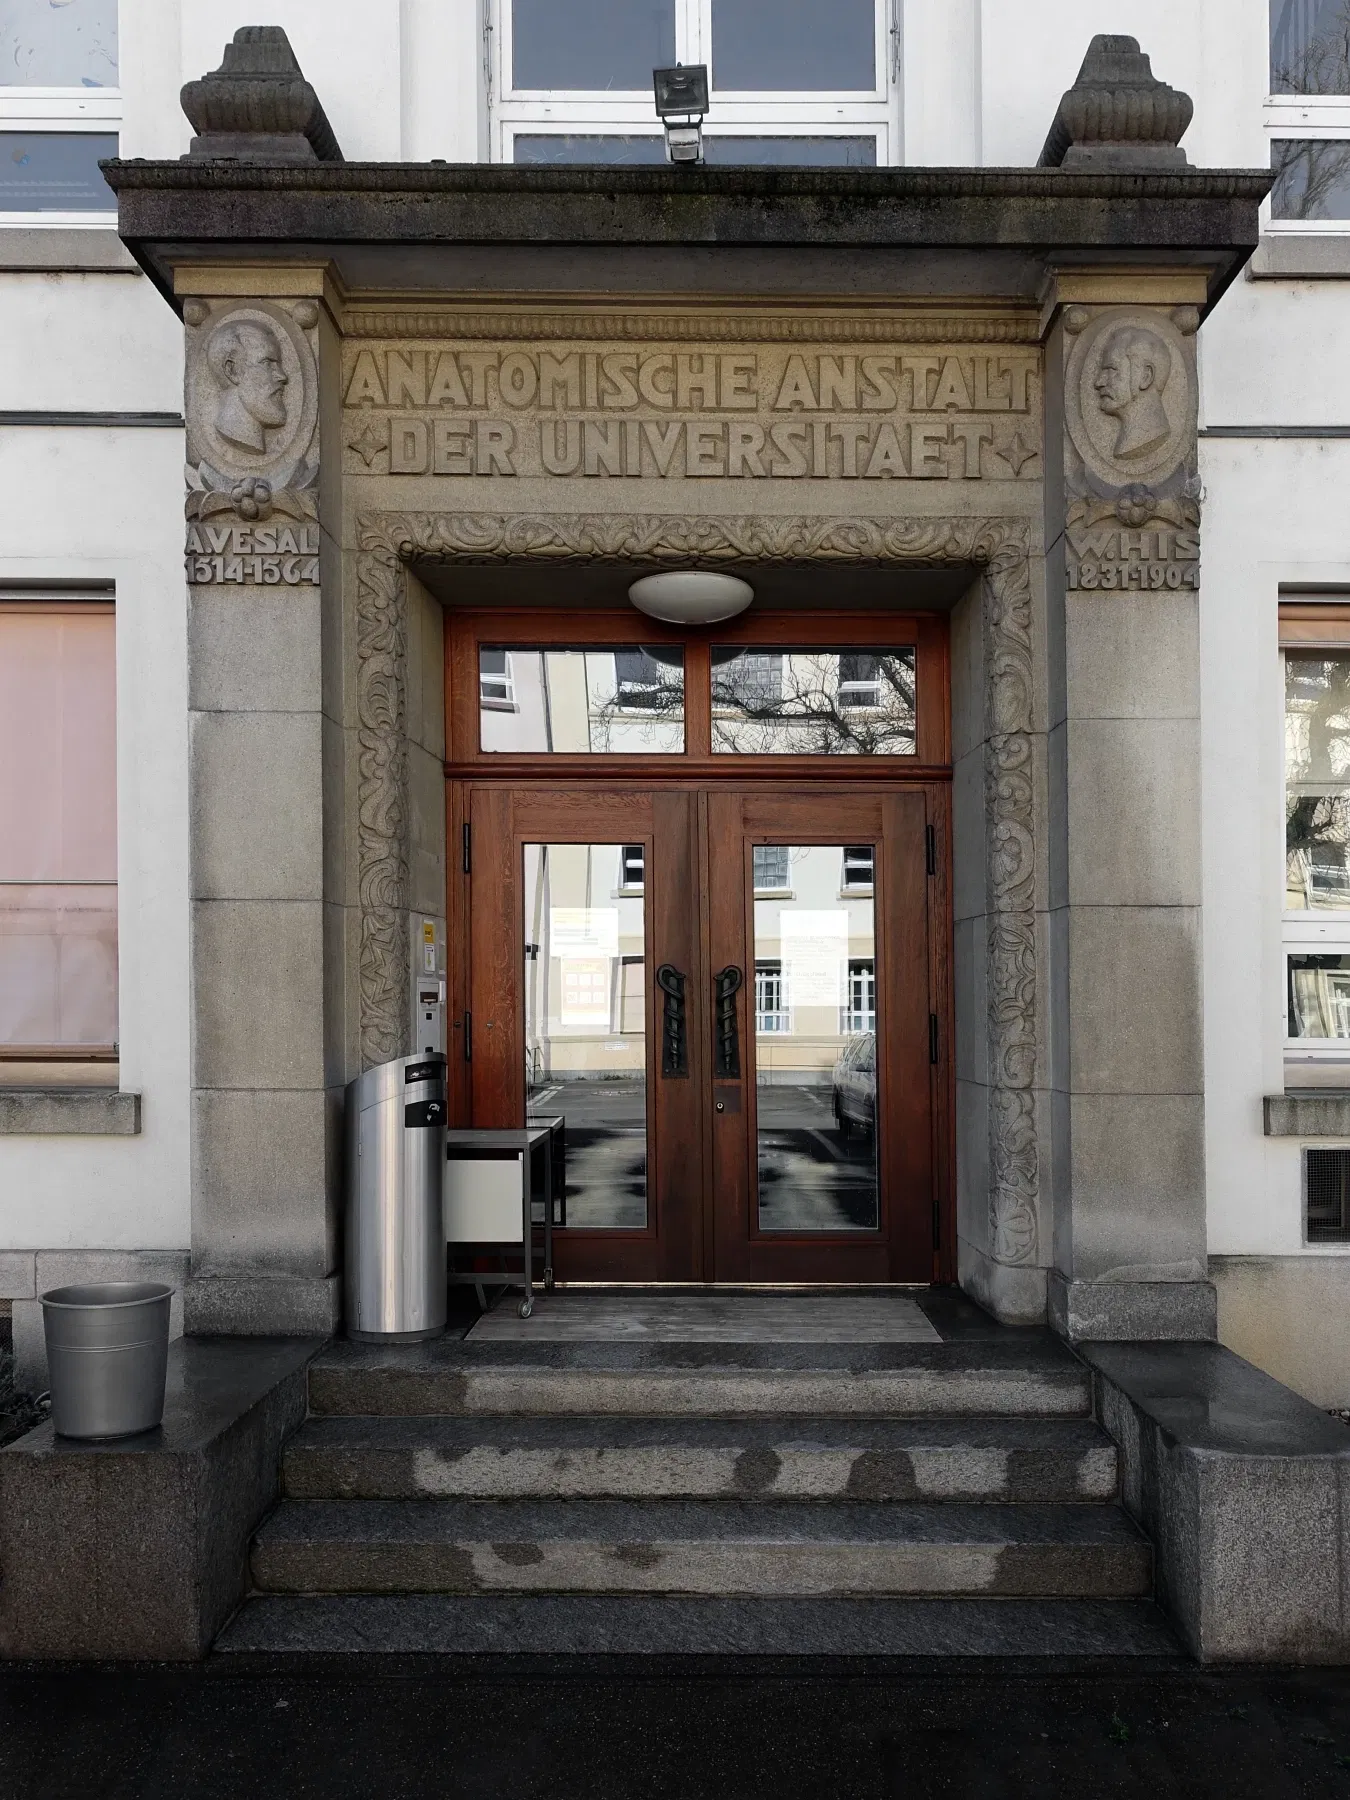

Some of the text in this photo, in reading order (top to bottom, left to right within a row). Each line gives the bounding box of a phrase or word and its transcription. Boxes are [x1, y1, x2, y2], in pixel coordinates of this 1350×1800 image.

[345, 350, 1038, 412] ANATOMISCHE ANSTALT
[389, 418, 994, 479] DER UNIVERSITAET
[185, 556, 320, 585] 1514-1564
[1065, 562, 1200, 589] 1831-1904
